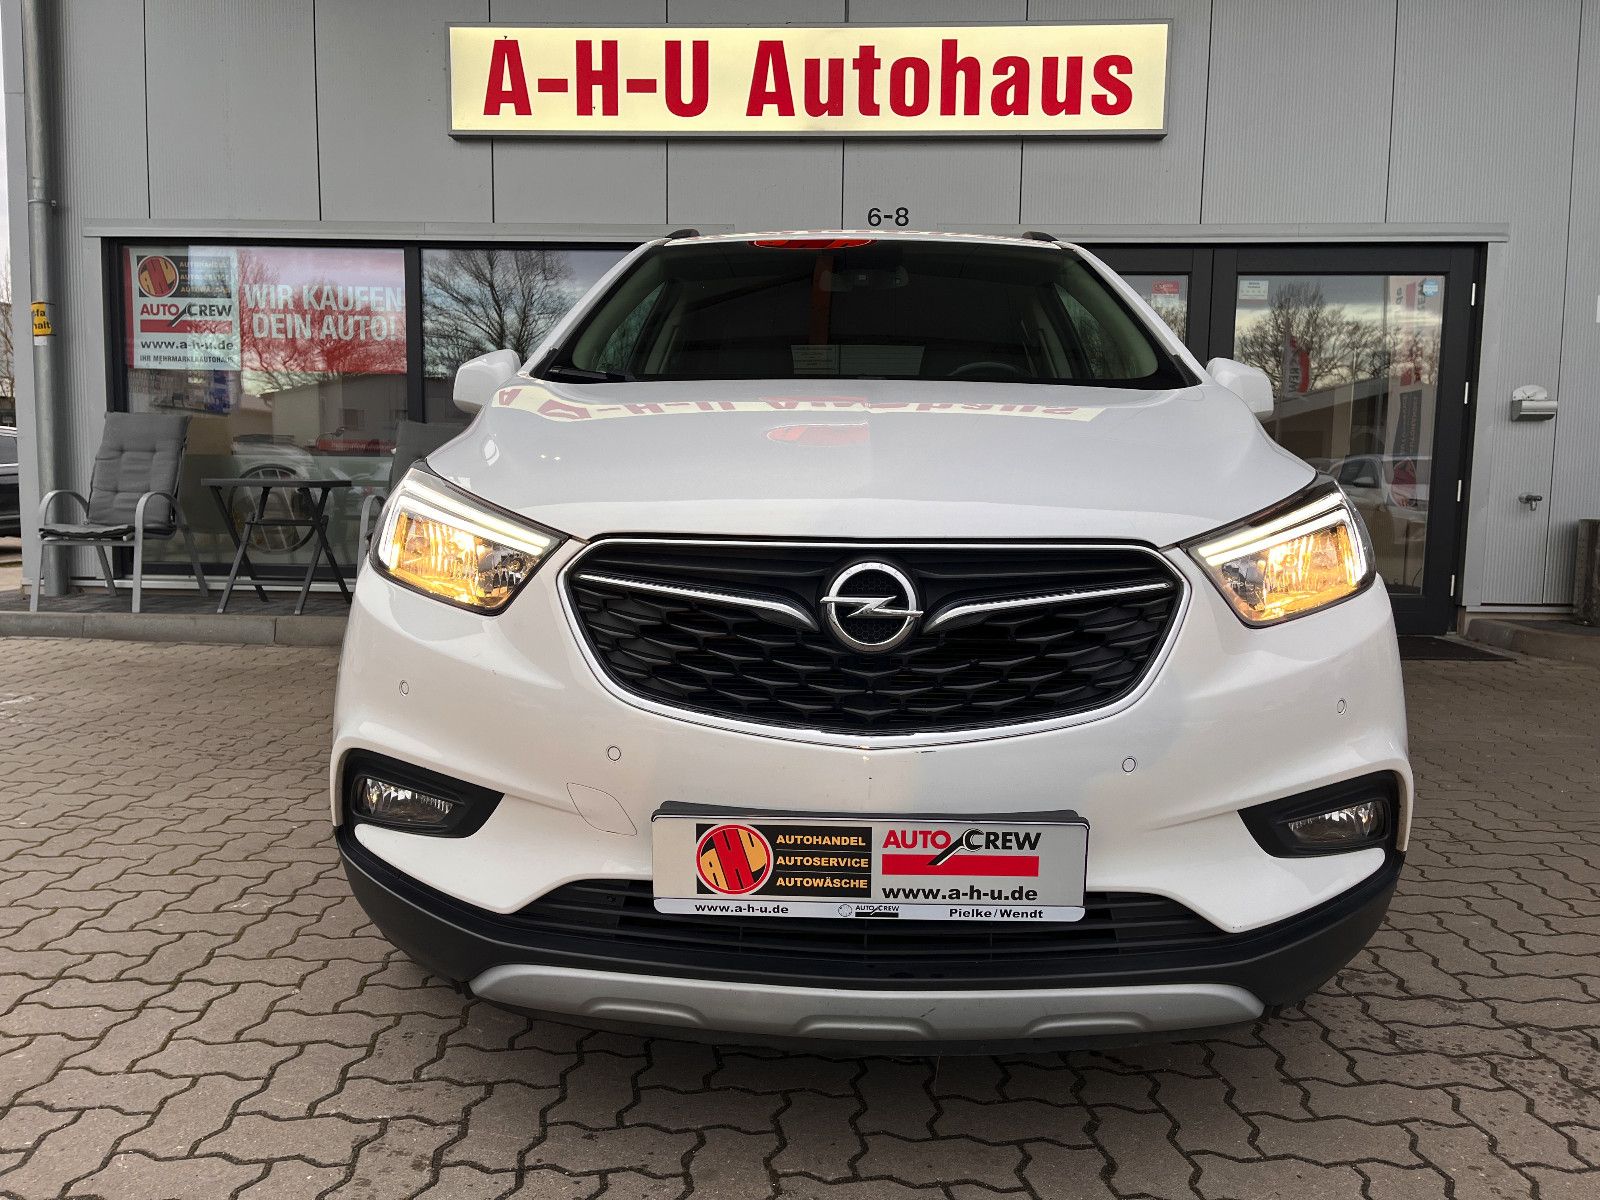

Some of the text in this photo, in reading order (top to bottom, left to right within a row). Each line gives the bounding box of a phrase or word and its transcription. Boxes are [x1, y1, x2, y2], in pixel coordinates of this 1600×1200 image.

[484, 38, 1133, 118] A-H-U Autohaus
[866, 207, 910, 228] 6-8
[243, 284, 402, 312] WIR KAUFEN
[253, 313, 397, 342] DEIN AUTO!
[776, 834, 866, 847] AUTOHANDEL
[776, 855, 869, 868] AUTOSERVICE
[776, 876, 868, 890] AUTOWÄSCHE
[882, 884, 1038, 902] www.a-h-u.de
[694, 903, 789, 915] www.a-h-u.de
